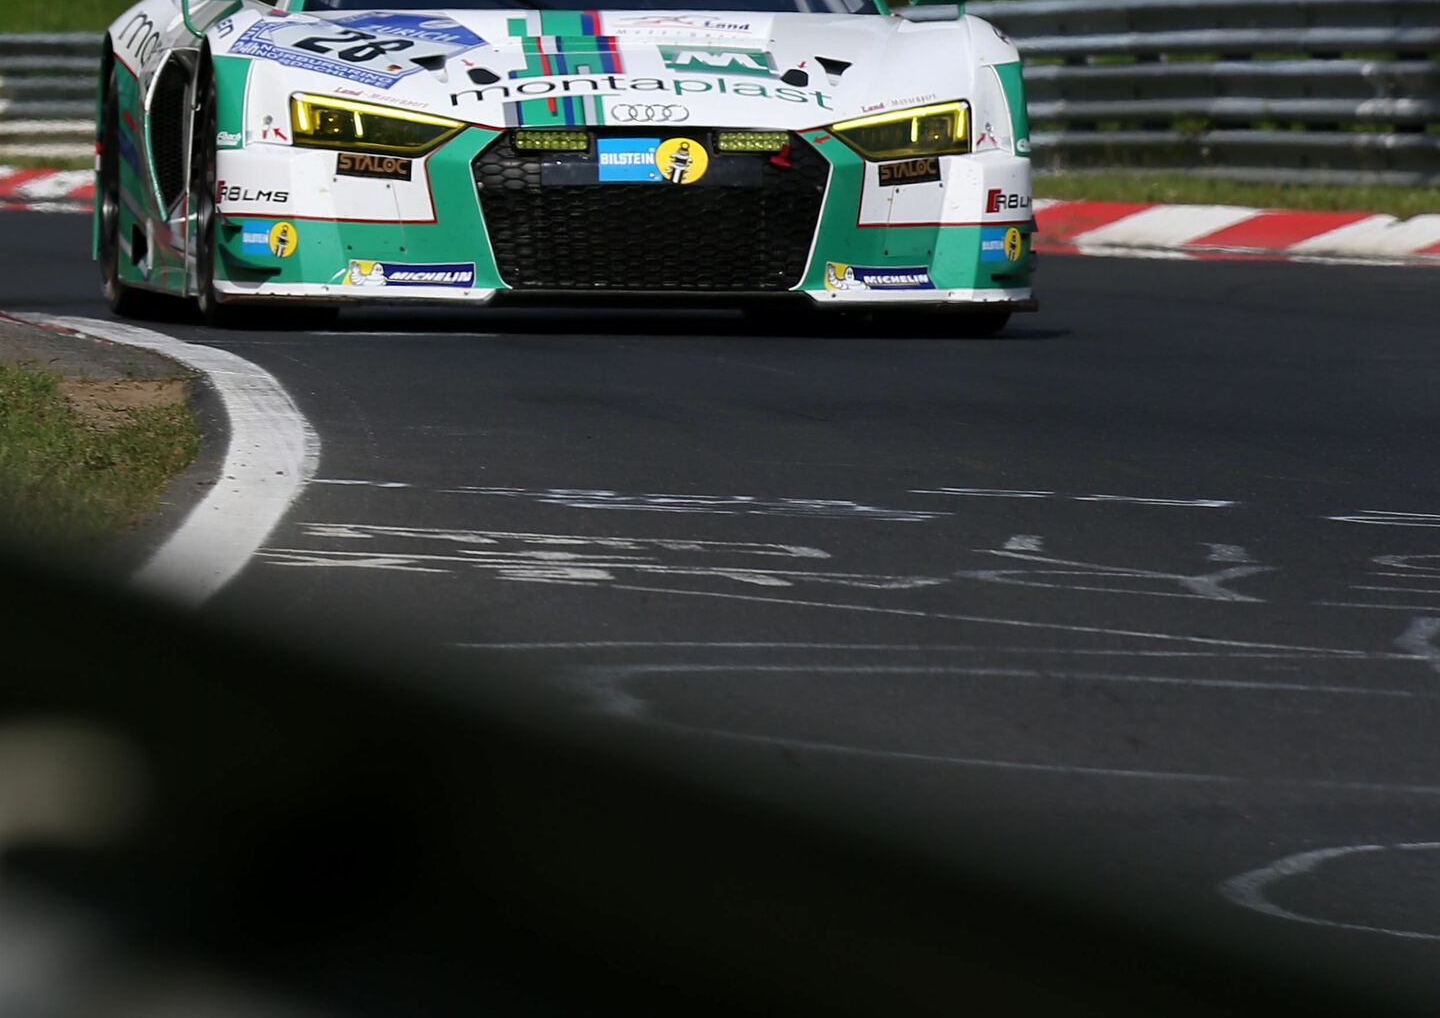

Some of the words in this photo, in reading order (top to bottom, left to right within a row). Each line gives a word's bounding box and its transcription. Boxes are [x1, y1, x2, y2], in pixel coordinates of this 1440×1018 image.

[704, 19, 752, 31] Land
[293, 30, 415, 63] 28
[450, 74, 834, 111] montaplast
[338, 153, 409, 175] STALOC
[600, 152, 655, 166] BILSTEIN
[880, 158, 937, 181] STALOC
[242, 188, 290, 203] LMS
[388, 270, 474, 284] MICHELIN
[863, 273, 930, 286] MICHELIN
